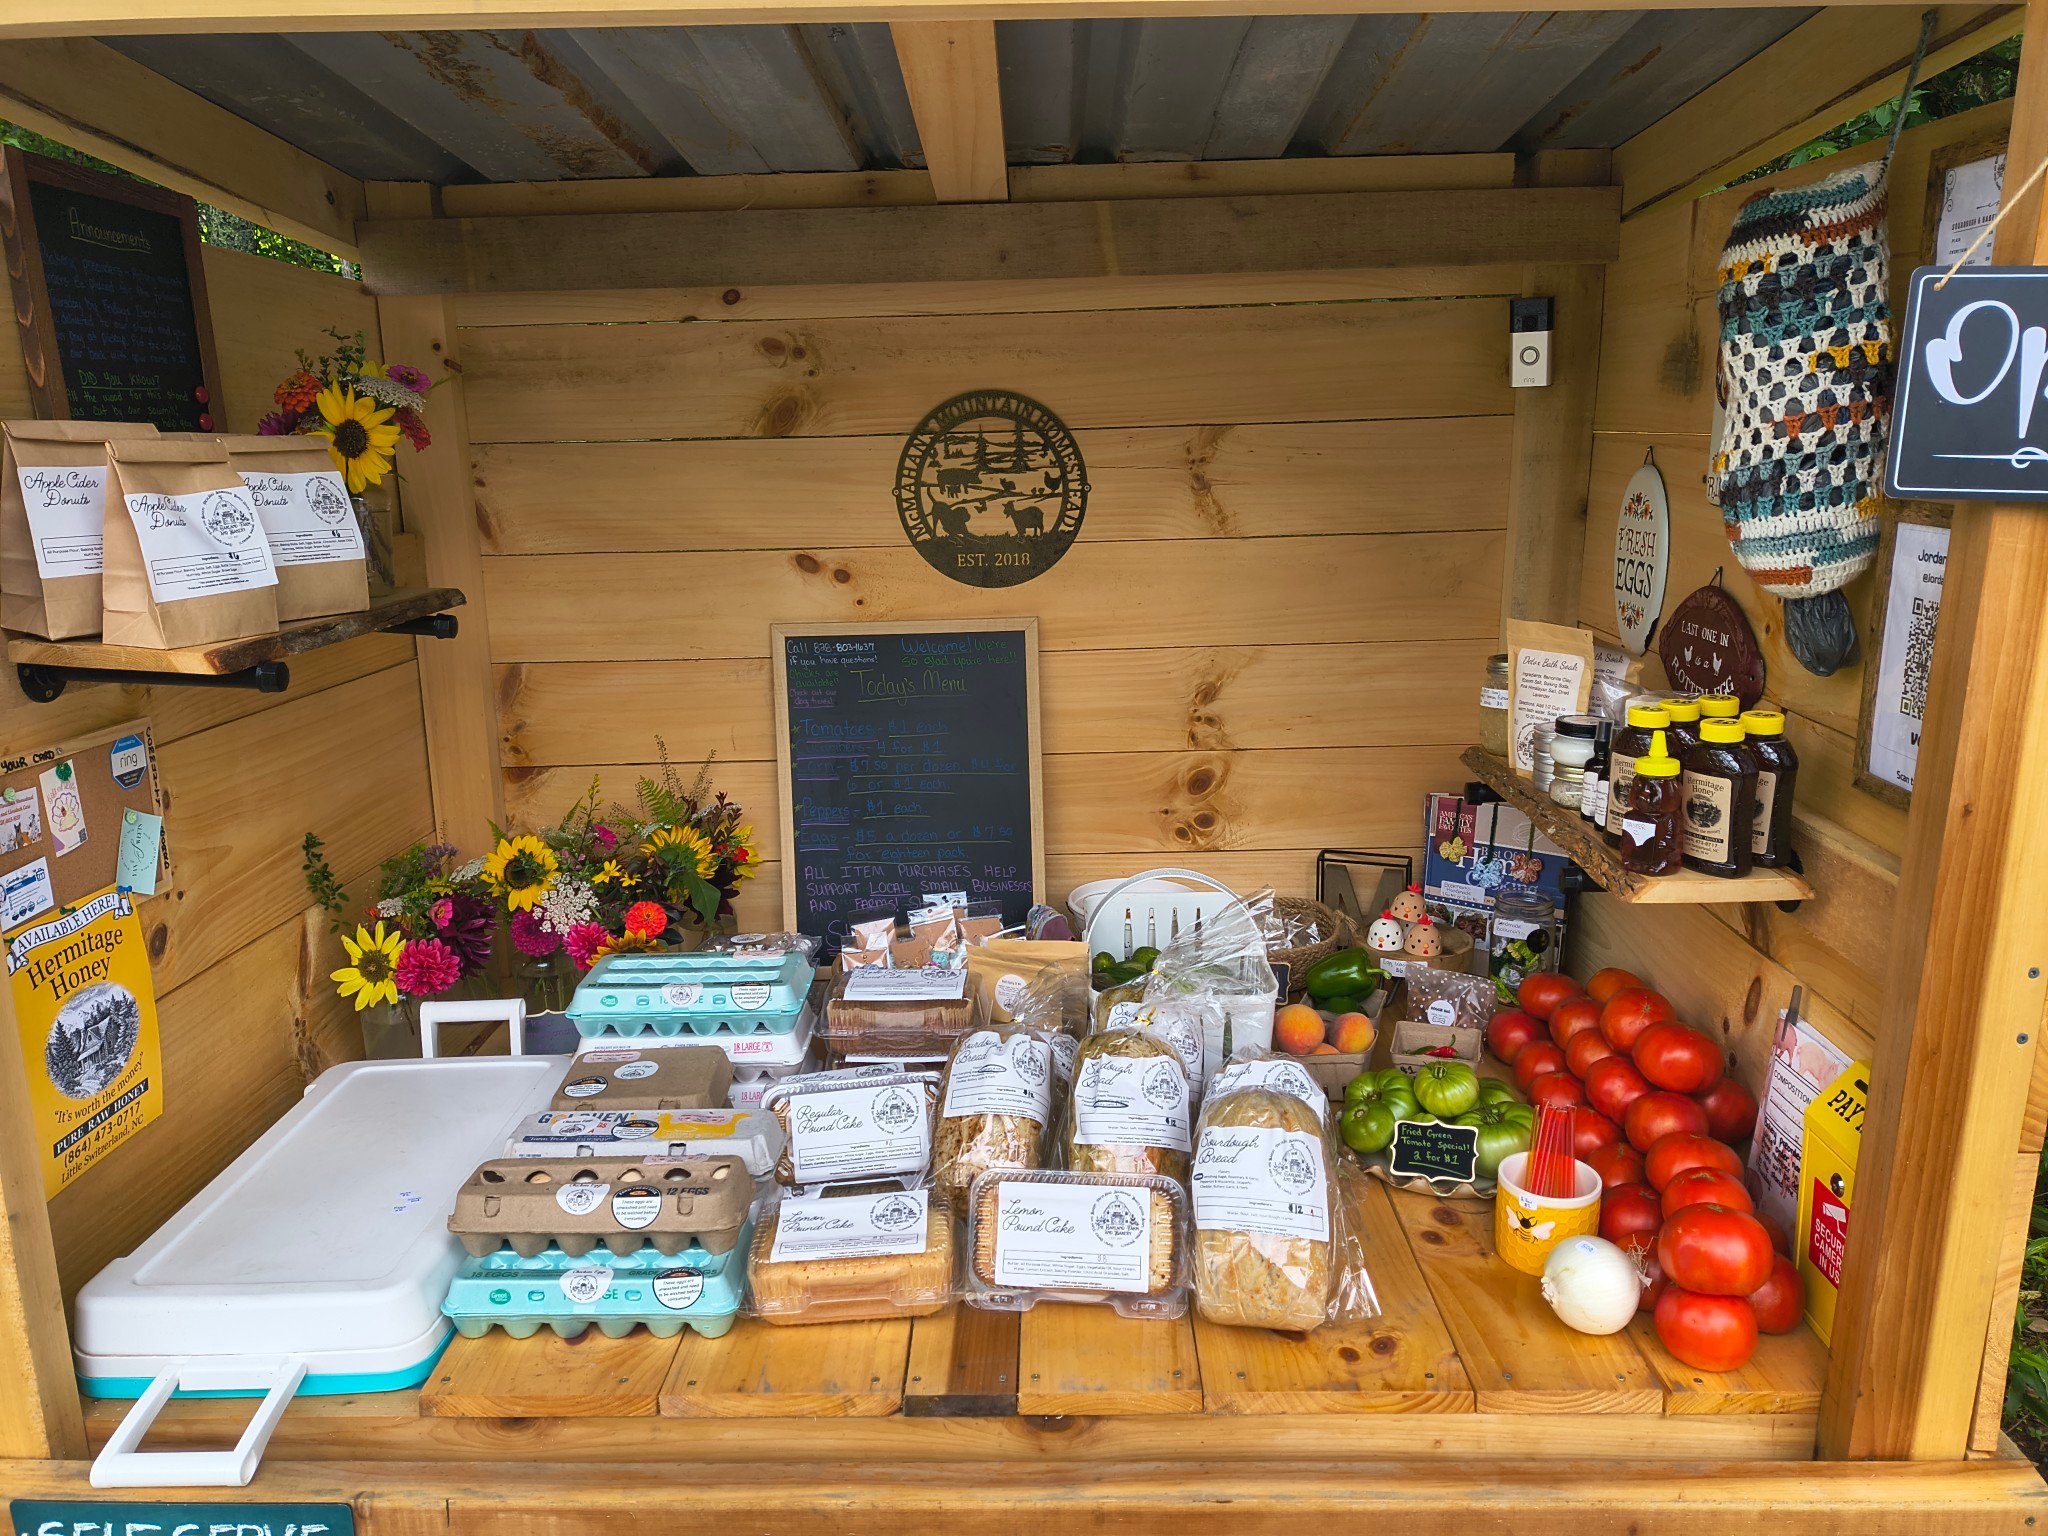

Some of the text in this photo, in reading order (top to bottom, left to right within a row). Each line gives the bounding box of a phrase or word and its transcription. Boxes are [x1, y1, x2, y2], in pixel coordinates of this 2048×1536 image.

[68, 206, 153, 250] Announcements
[24, 471, 99, 493] Apple Cider
[268, 477, 294, 492] Cider
[43, 488, 91, 508] Donuts
[131, 495, 166, 516] Apple
[252, 491, 289, 507] Donuts
[150, 511, 188, 531] Donuts
[1618, 527, 1658, 557] FRESH
[957, 552, 1031, 568] EST. 2018
[1615, 558, 1655, 599] EGGS
[1681, 620, 1730, 648] LAST ONE IN
[787, 640, 809, 656] Call
[899, 635, 972, 656] Welcome!
[800, 659, 817, 671] you
[819, 655, 839, 669] have
[841, 655, 880, 670] questions!
[1522, 655, 1541, 667] Detox
[1560, 660, 1580, 672] Soak
[850, 668, 916, 706] Today's
[922, 669, 968, 693] Menu
[801, 718, 876, 738] Tomatoes
[892, 741, 914, 755] for
[0, 748, 56, 774] YOUR CARD
[119, 751, 139, 769] ring
[1686, 776, 1726, 793] Hermitage
[1692, 784, 1717, 798] Honey
[802, 797, 851, 824] Peppers
[848, 847, 868, 863] for
[804, 864, 1017, 880] ALL ITEM PURCHASES HELP
[806, 878, 1032, 898] SUPPORT LOCAL SMALL BUSINESSES
[809, 899, 838, 912] AND
[854, 895, 900, 912] FARMS!
[18, 895, 117, 954] AVAILABLE HERE!
[25, 928, 124, 991] Hermitage
[49, 955, 111, 1001] Honey
[733, 1041, 762, 1052] 18 LARGE
[1773, 1069, 1812, 1105] COMPOSITION
[75, 1096, 101, 1120] worth
[102, 1086, 117, 1108] the
[1826, 1088, 1866, 1124] PAY
[55, 1079, 148, 1156] PURE RAW HONEY
[796, 1104, 845, 1123] Regular
[63, 1099, 142, 1169] (864) 473-0717
[796, 1114, 865, 1135] Pound Cake
[1401, 1124, 1453, 1140] Fried Green
[61, 1113, 145, 1185] Little Switzerland, NC
[1201, 1130, 1260, 1153] Sourdough
[1400, 1135, 1432, 1148] Tomato
[1199, 1146, 1245, 1166] Bread
[1413, 1150, 1422, 1161] 2
[1426, 1150, 1441, 1163] for
[667, 1186, 711, 1196] 12 EGGS
[782, 1211, 826, 1224] Lemon
[1001, 1198, 1046, 1217] Lemon
[782, 1217, 856, 1234] Pound Cake
[1002, 1216, 1076, 1235] Pound Cake
[1818, 1252, 1828, 1272] IN
[470, 1270, 520, 1279] 18 EGGS
